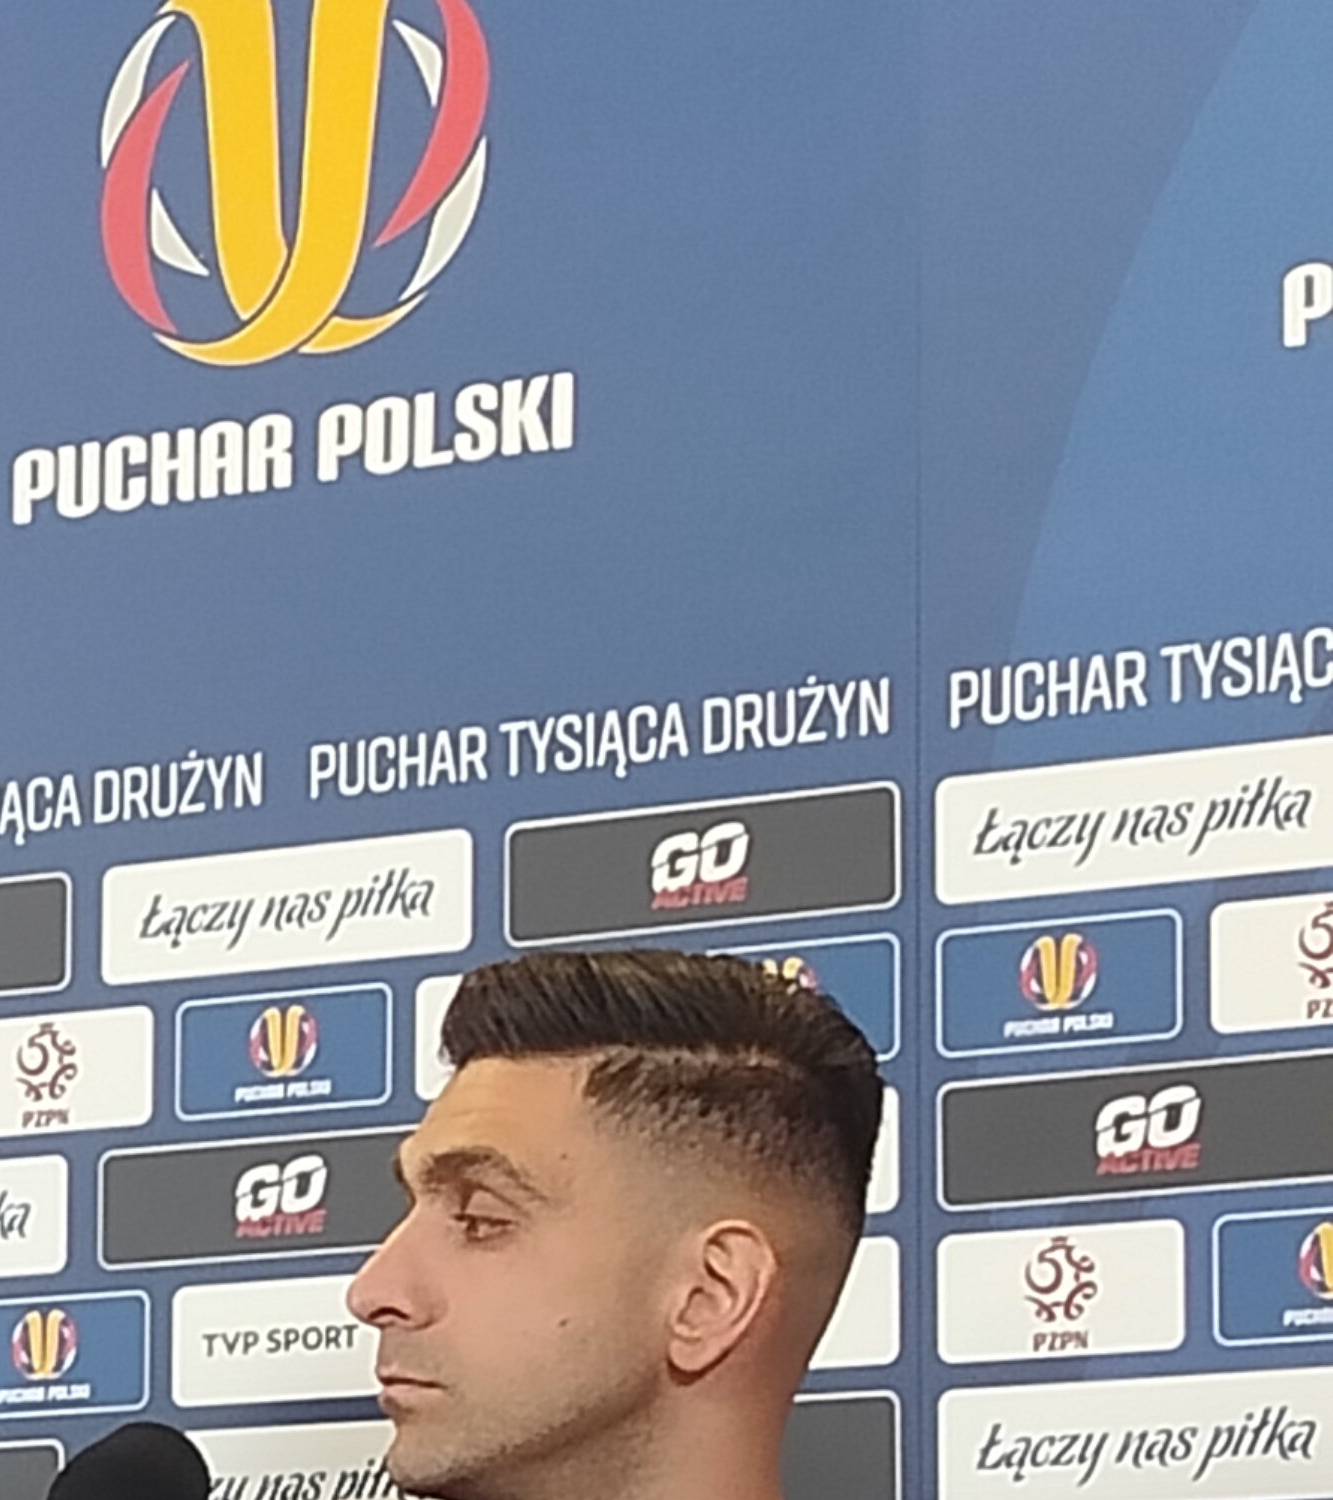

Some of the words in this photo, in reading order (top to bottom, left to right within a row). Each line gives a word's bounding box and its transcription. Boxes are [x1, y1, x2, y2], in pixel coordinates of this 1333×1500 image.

[13, 413, 293, 524] PUCHAR
[317, 372, 574, 482] POLSKI
[950, 651, 1147, 728] PUCHAR
[1160, 627, 1333, 703] TYSIĄC
[310, 726, 488, 799] PUCHAR
[499, 702, 689, 779] TYSIĄCA
[702, 675, 890, 754] DRUŻYN
[93, 749, 263, 824] DRUŻYN
[973, 808, 1106, 867] Łączy
[1112, 800, 1193, 846] nas
[1188, 776, 1313, 857] piłka
[650, 821, 749, 892] GO
[138, 895, 256, 951] Łączy
[260, 885, 329, 927] nas
[326, 866, 436, 943] piłka
[651, 876, 748, 910] ACTIVE
[1307, 999, 1333, 1019] PZ
[21, 1108, 70, 1129] PZPN
[1095, 1085, 1202, 1158] GO
[235, 1155, 328, 1223] GO
[1095, 1143, 1202, 1175] ACTIVE
[235, 1210, 327, 1238] ACTIVE
[203, 1331, 259, 1358] TVP
[267, 1324, 358, 1355] SPORT
[1033, 1331, 1089, 1351] PZPN
[976, 1422, 1109, 1487] Łączy
[1115, 1426, 1199, 1469] nas
[1192, 1405, 1317, 1482] piłka
